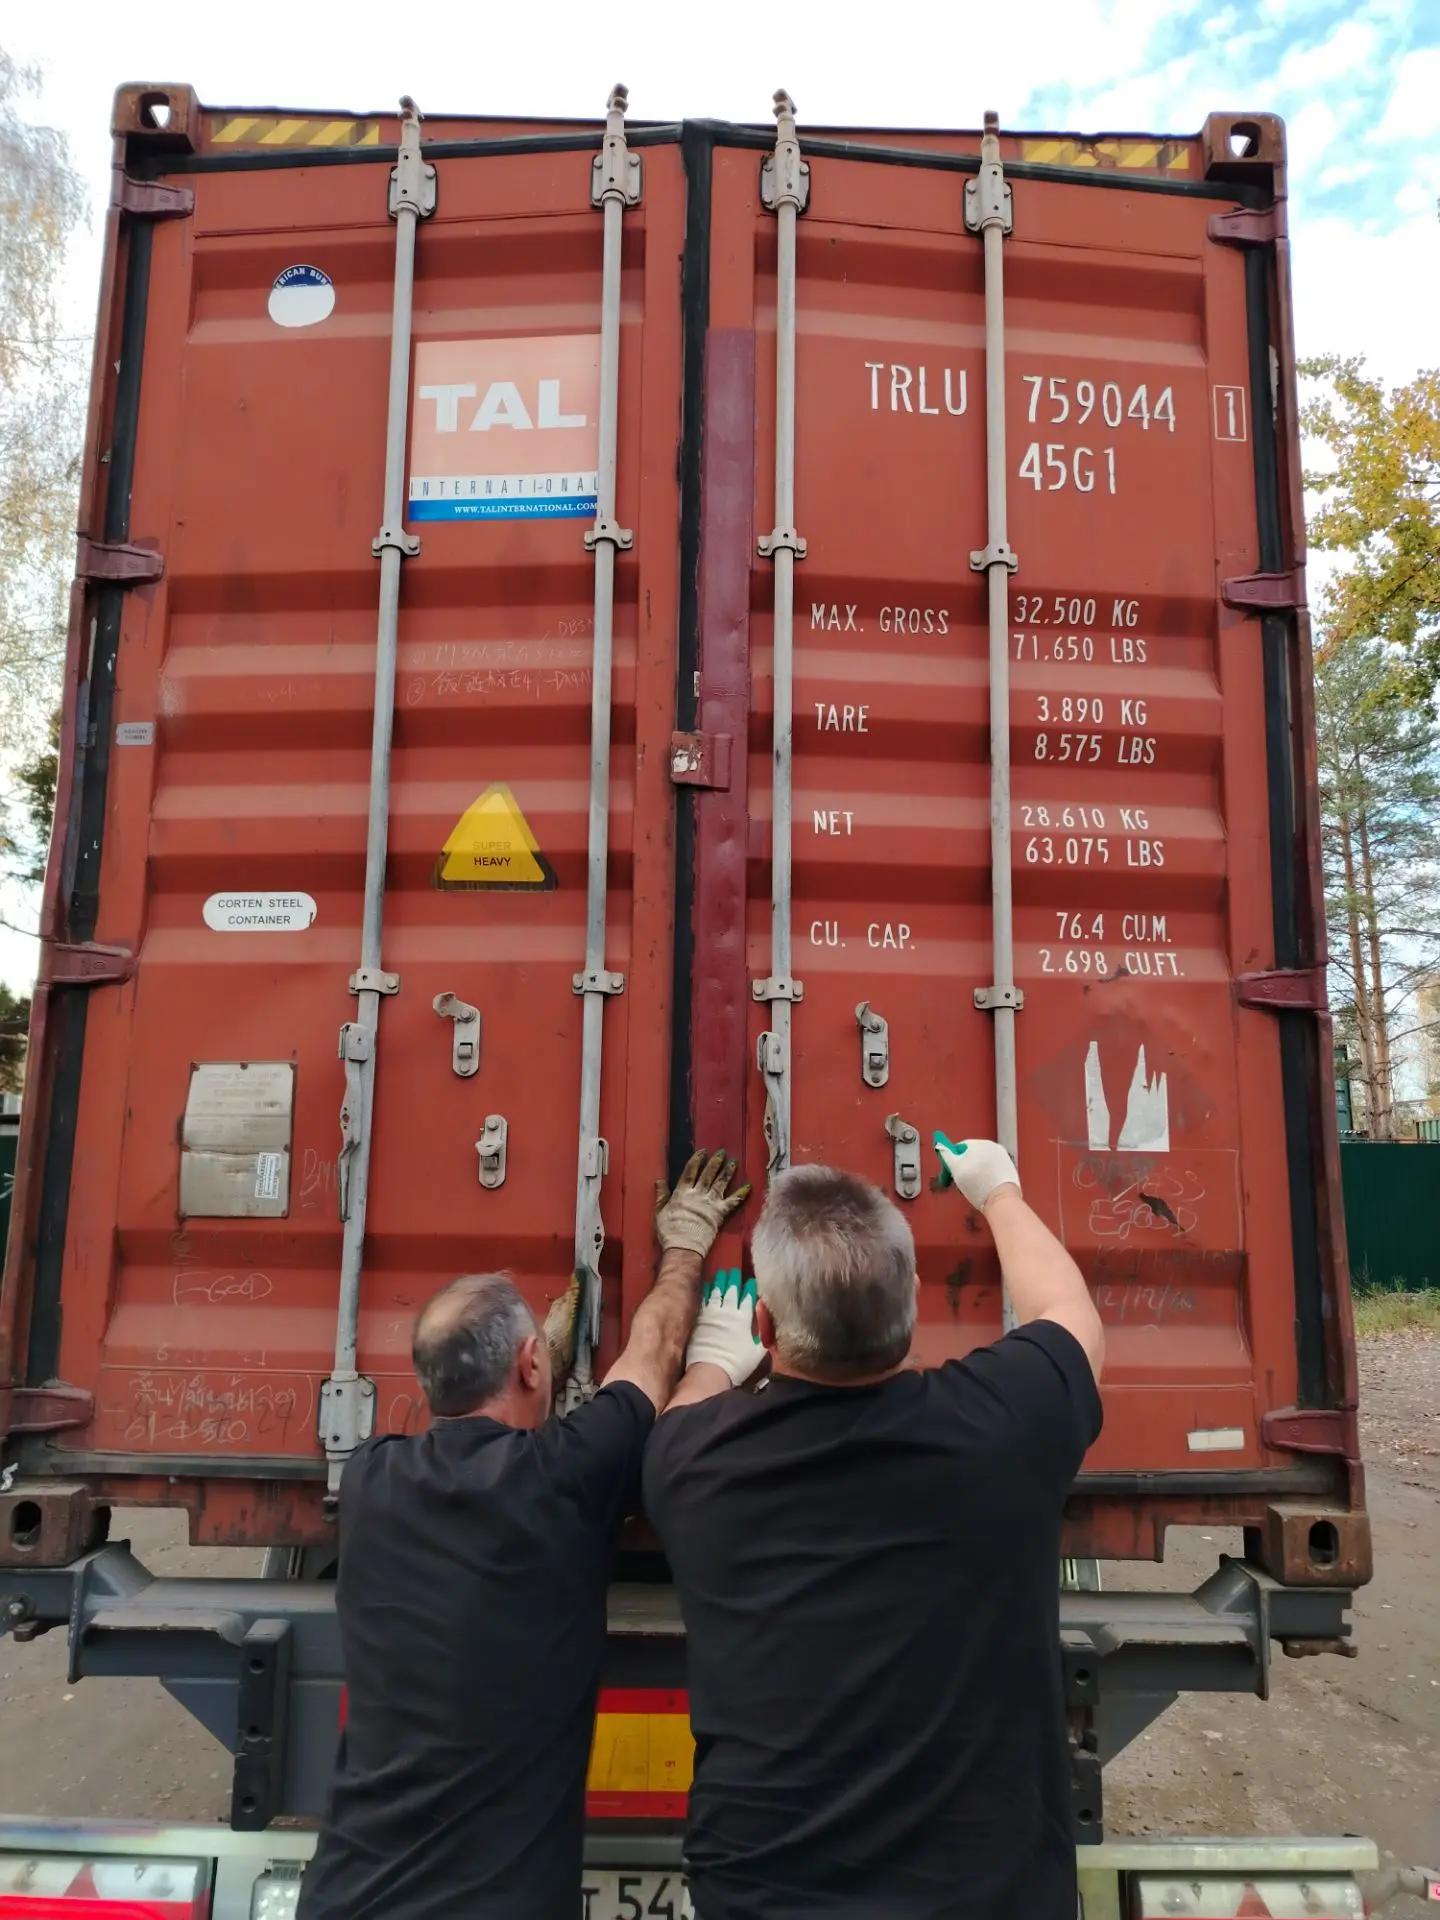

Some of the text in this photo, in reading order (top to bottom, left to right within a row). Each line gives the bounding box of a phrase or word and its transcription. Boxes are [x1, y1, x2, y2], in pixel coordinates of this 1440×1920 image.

[418, 379, 588, 433] TAL
[865, 361, 1237, 437] TRLU 759044 1
[1018, 442, 1117, 495] 45G1
[454, 502, 597, 514] WWW.TALINTERNATIONAL.COM
[811, 595, 1140, 635] MAX. GROSS 32,500 KG
[1013, 634, 1147, 663] 71,650 LBS
[815, 696, 1147, 733] TARE 3,890 KG
[1034, 733, 1157, 764] 8,575 LBS
[813, 810, 854, 836] NET
[1119, 808, 1149, 830] KG
[471, 840, 512, 851] SUPER
[1025, 837, 1164, 867] 63,075 LBS
[473, 857, 512, 867] HEAVY
[217, 898, 304, 908] CORTEN STEEL
[227, 915, 292, 925] CONTAINER
[811, 912, 1172, 949] CU. CAP. 76.4 CU.M.
[1125, 951, 1185, 977] CU.FT.
